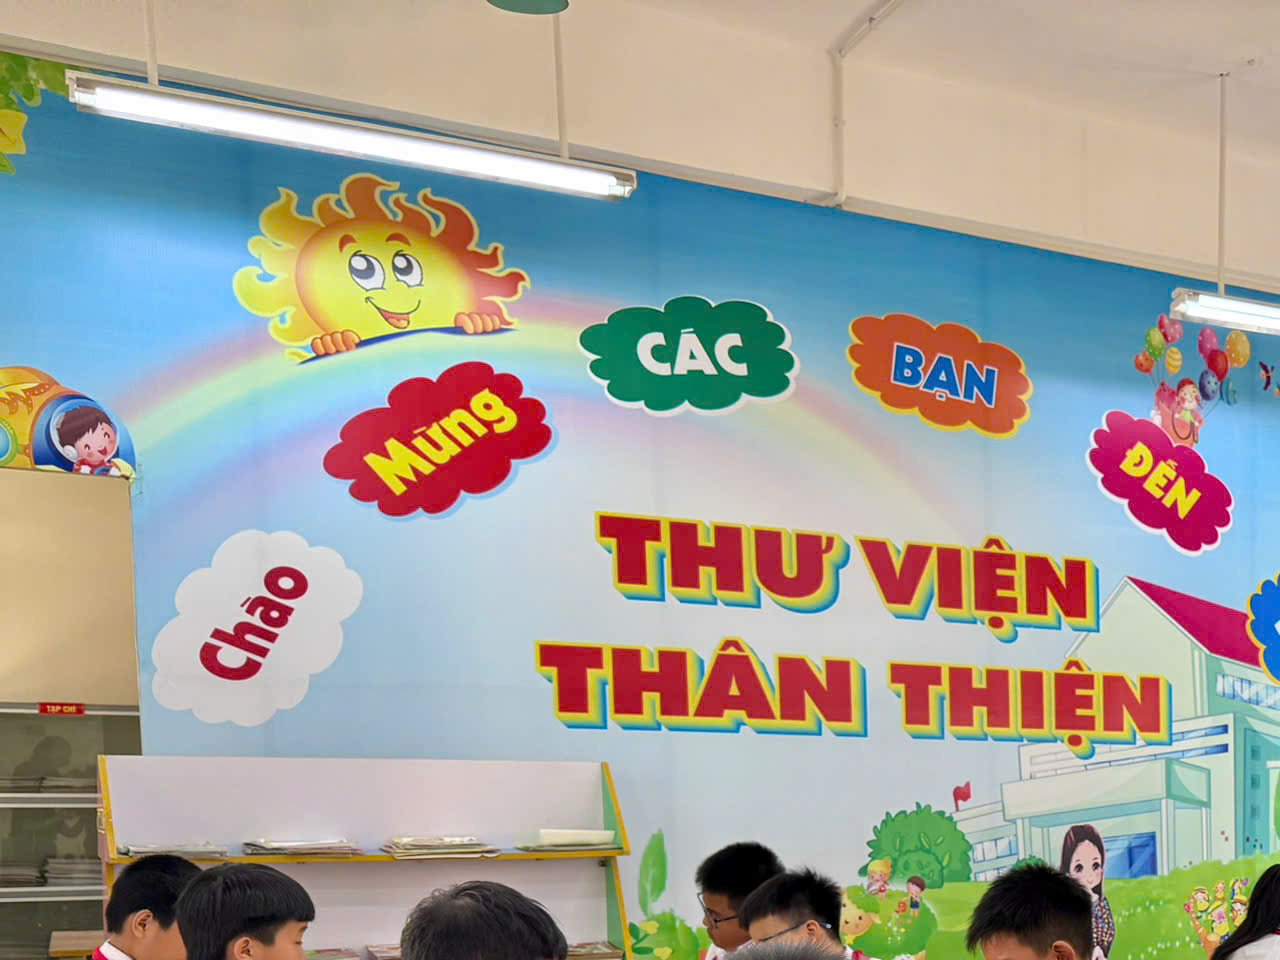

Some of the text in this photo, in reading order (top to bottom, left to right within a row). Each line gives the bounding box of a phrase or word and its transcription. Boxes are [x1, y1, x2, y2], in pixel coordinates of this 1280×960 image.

[637, 326, 750, 378] CÁC
[889, 341, 999, 409] BẠN
[362, 386, 520, 497] Mừng
[1118, 438, 1204, 521] ĐẾN
[198, 564, 310, 682] Chào
[594, 511, 1100, 643] THƯ VIỆN
[46, 704, 61, 714] TẠP
[535, 636, 1172, 760] THÂN THIỆN
